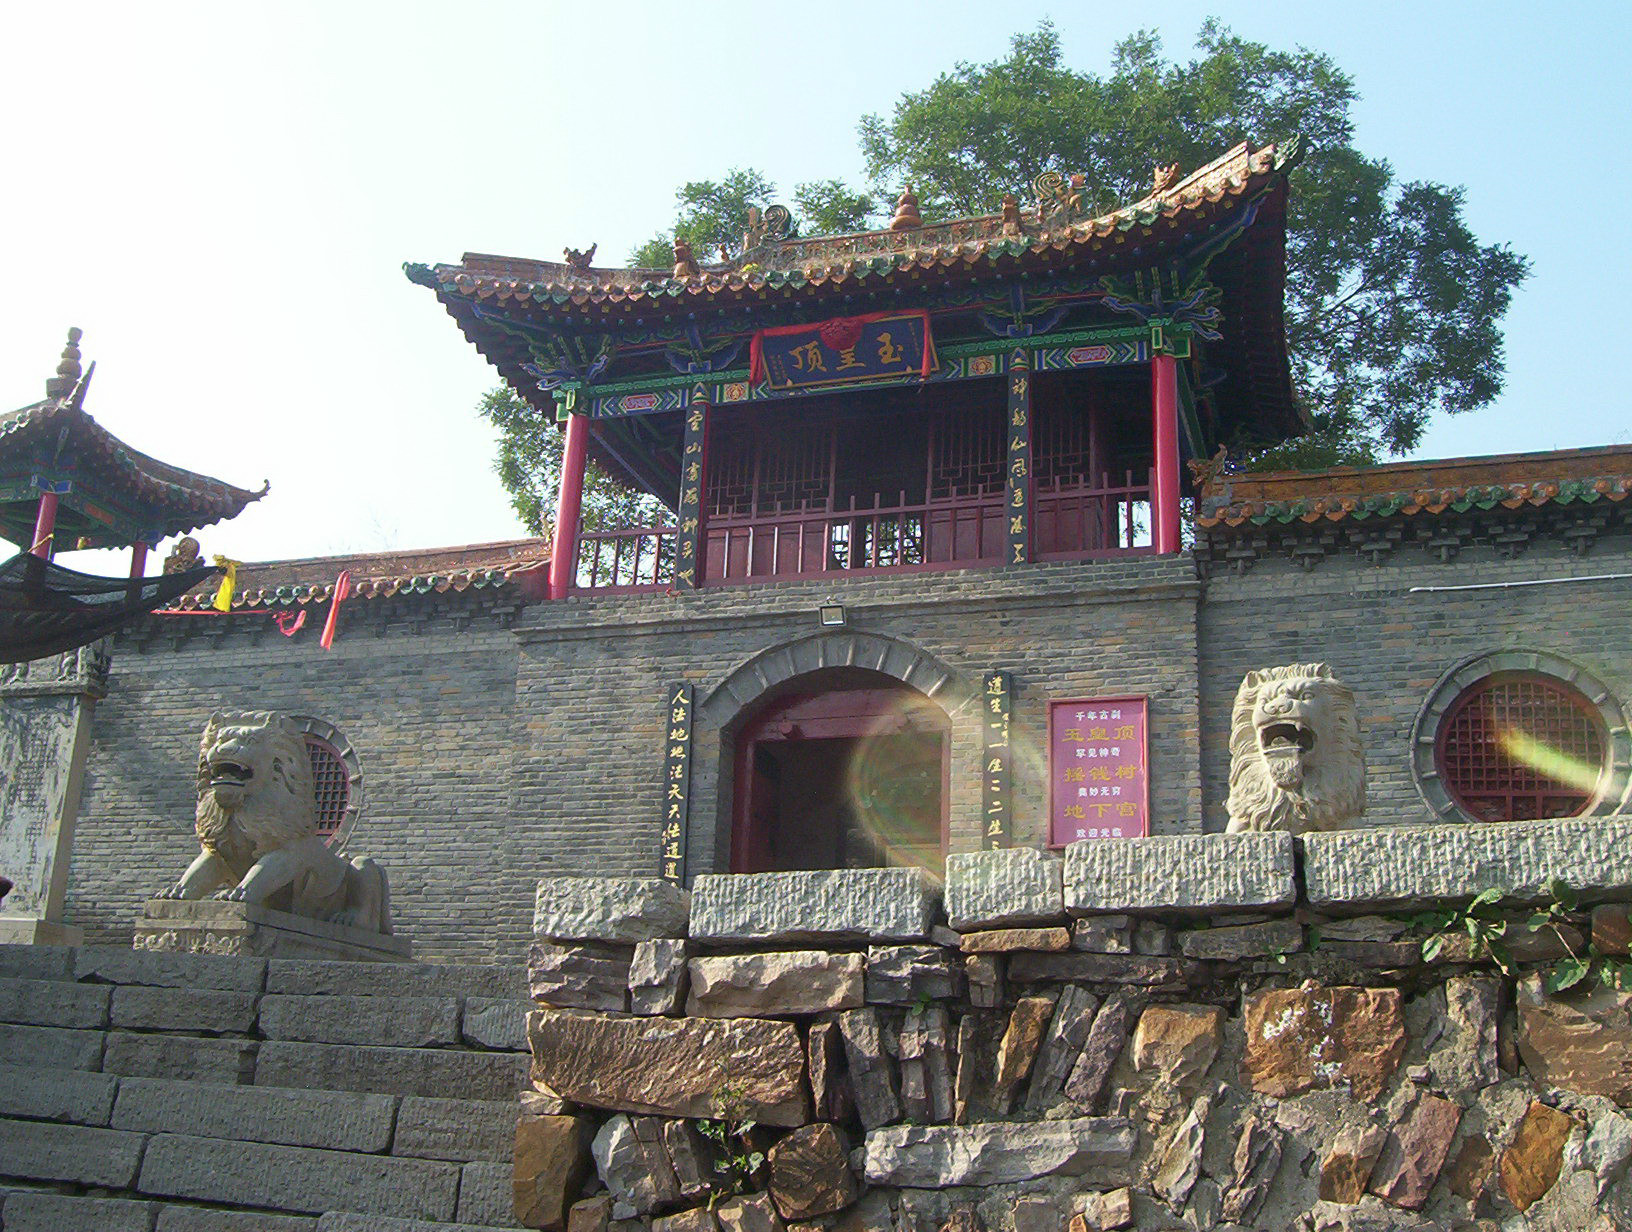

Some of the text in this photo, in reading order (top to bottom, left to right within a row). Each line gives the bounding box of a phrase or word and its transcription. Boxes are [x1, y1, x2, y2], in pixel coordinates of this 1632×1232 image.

[1075, 709, 1121, 721] 千年古刹
[664, 688, 690, 888] 人法地地法天天法道道
[1063, 802, 1137, 819] 地下宫
